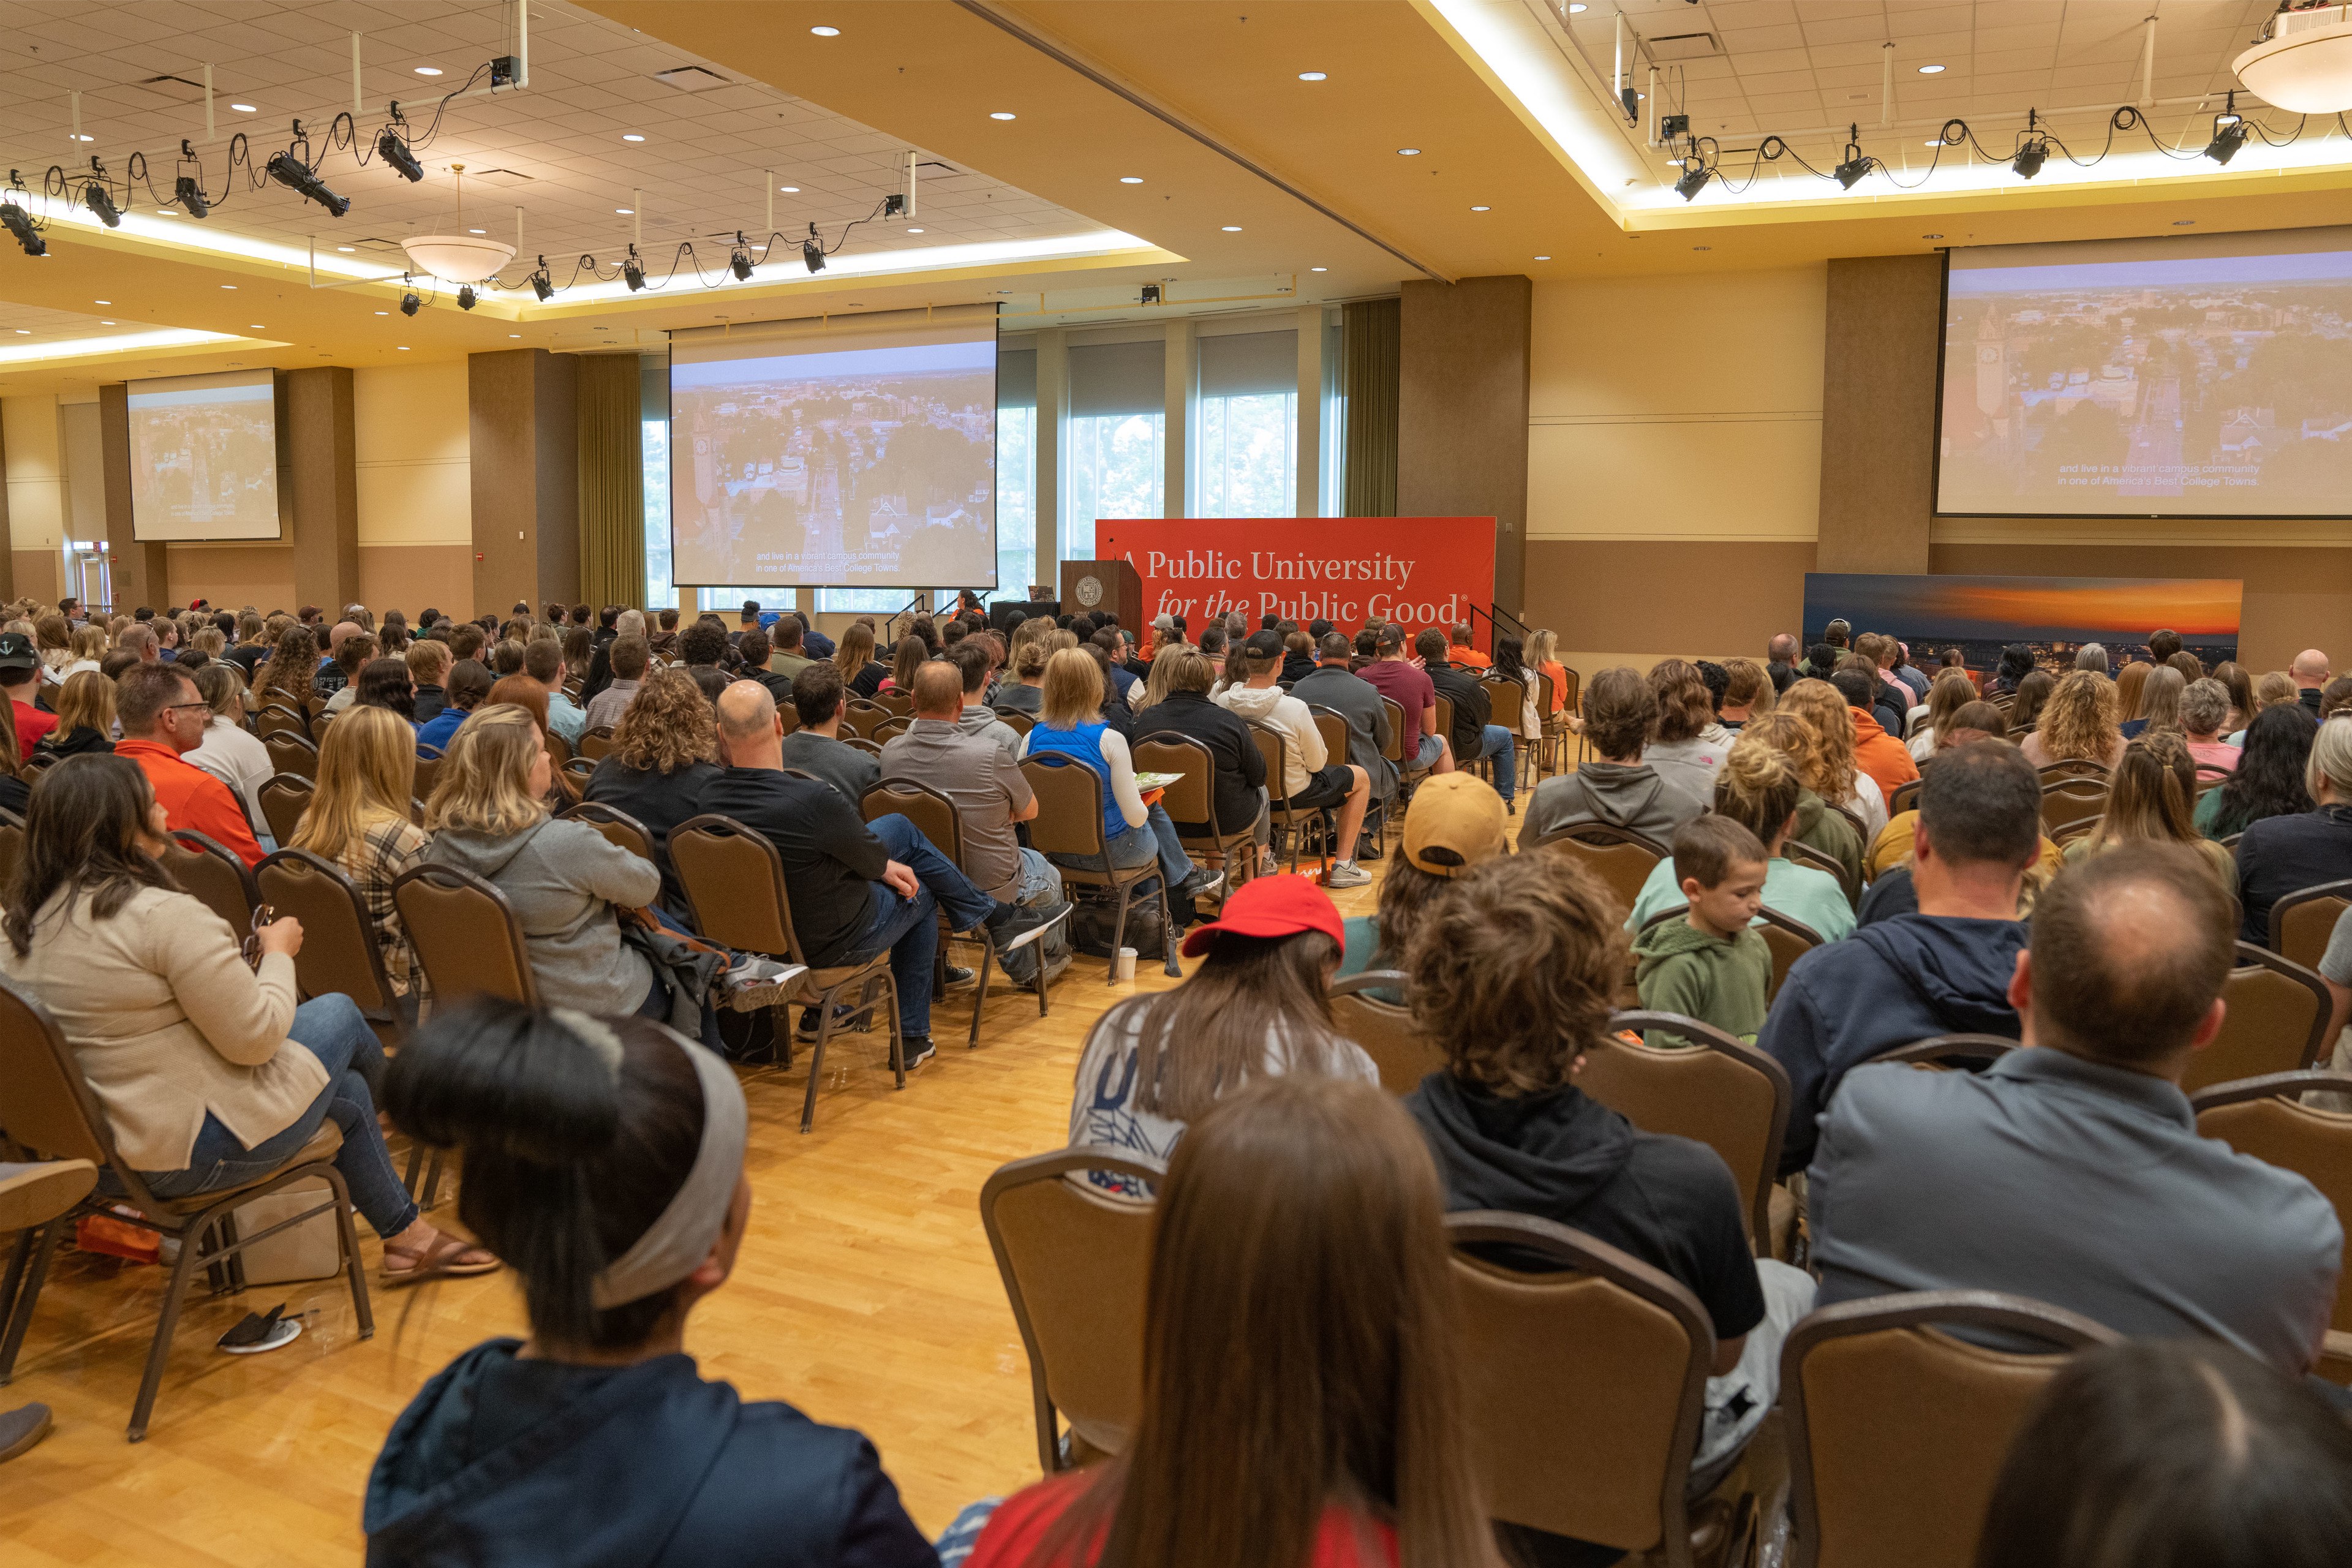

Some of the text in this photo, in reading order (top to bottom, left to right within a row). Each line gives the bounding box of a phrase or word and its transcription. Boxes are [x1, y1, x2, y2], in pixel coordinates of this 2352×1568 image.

[2060, 464, 2078, 473] and
[2081, 464, 2098, 473] live
[2101, 464, 2109, 473] in
[2158, 467, 2199, 475] campus
[2203, 465, 2260, 475] community
[2058, 477, 2066, 485] in
[2090, 477, 2100, 485] of
[2103, 477, 2151, 485] America's
[2155, 477, 2177, 485] Best
[2180, 477, 2220, 488] College
[2224, 477, 2259, 486] Towns.
[757, 552, 770, 560] and
[772, 552, 784, 560] live
[827, 554, 856, 562] campus
[859, 551, 899, 562] community
[756, 564, 762, 572] in
[844, 564, 872, 574] College
[1147, 550, 1242, 579] Public
[1250, 552, 1415, 590] University
[1148, 589, 1197, 626] for
[1204, 590, 1250, 619] the
[1257, 592, 1357, 622] Public
